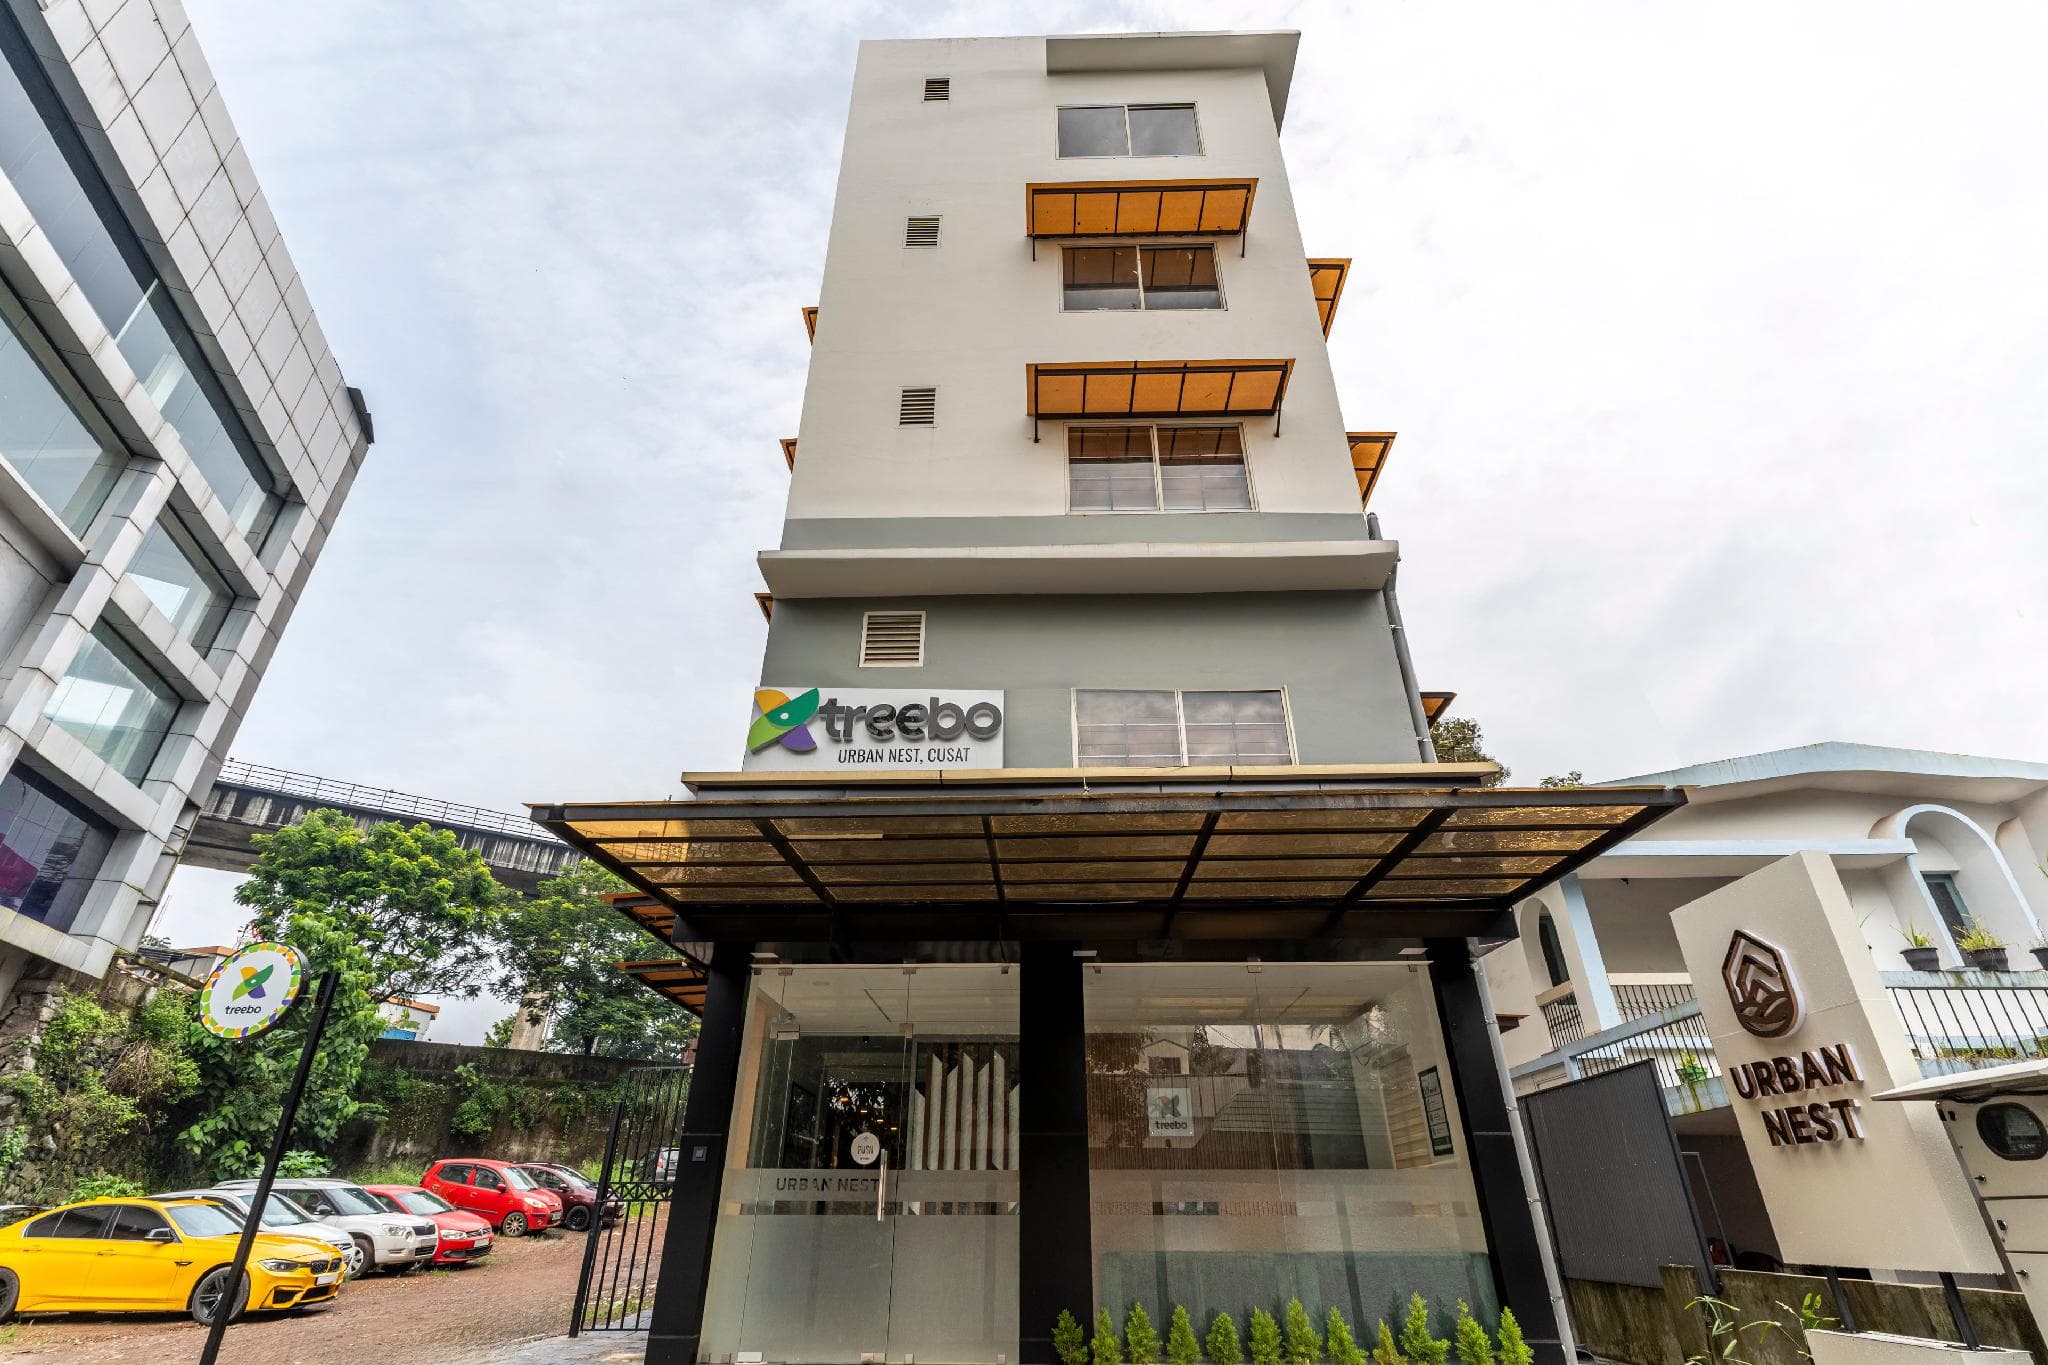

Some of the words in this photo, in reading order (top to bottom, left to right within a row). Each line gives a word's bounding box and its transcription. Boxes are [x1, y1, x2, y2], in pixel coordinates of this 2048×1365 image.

[819, 697, 1002, 742] treebo
[837, 748, 884, 763] URBAN
[888, 748, 923, 765] NEST,
[927, 747, 971, 762] CUSAT
[225, 1004, 262, 1015] treebo
[1729, 1044, 1864, 1101] URBAN
[1155, 1120, 1188, 1130] treebo
[1761, 1098, 1865, 1148] NEST
[776, 1177, 833, 1192] URBAN
[837, 1177, 880, 1192] NEST
